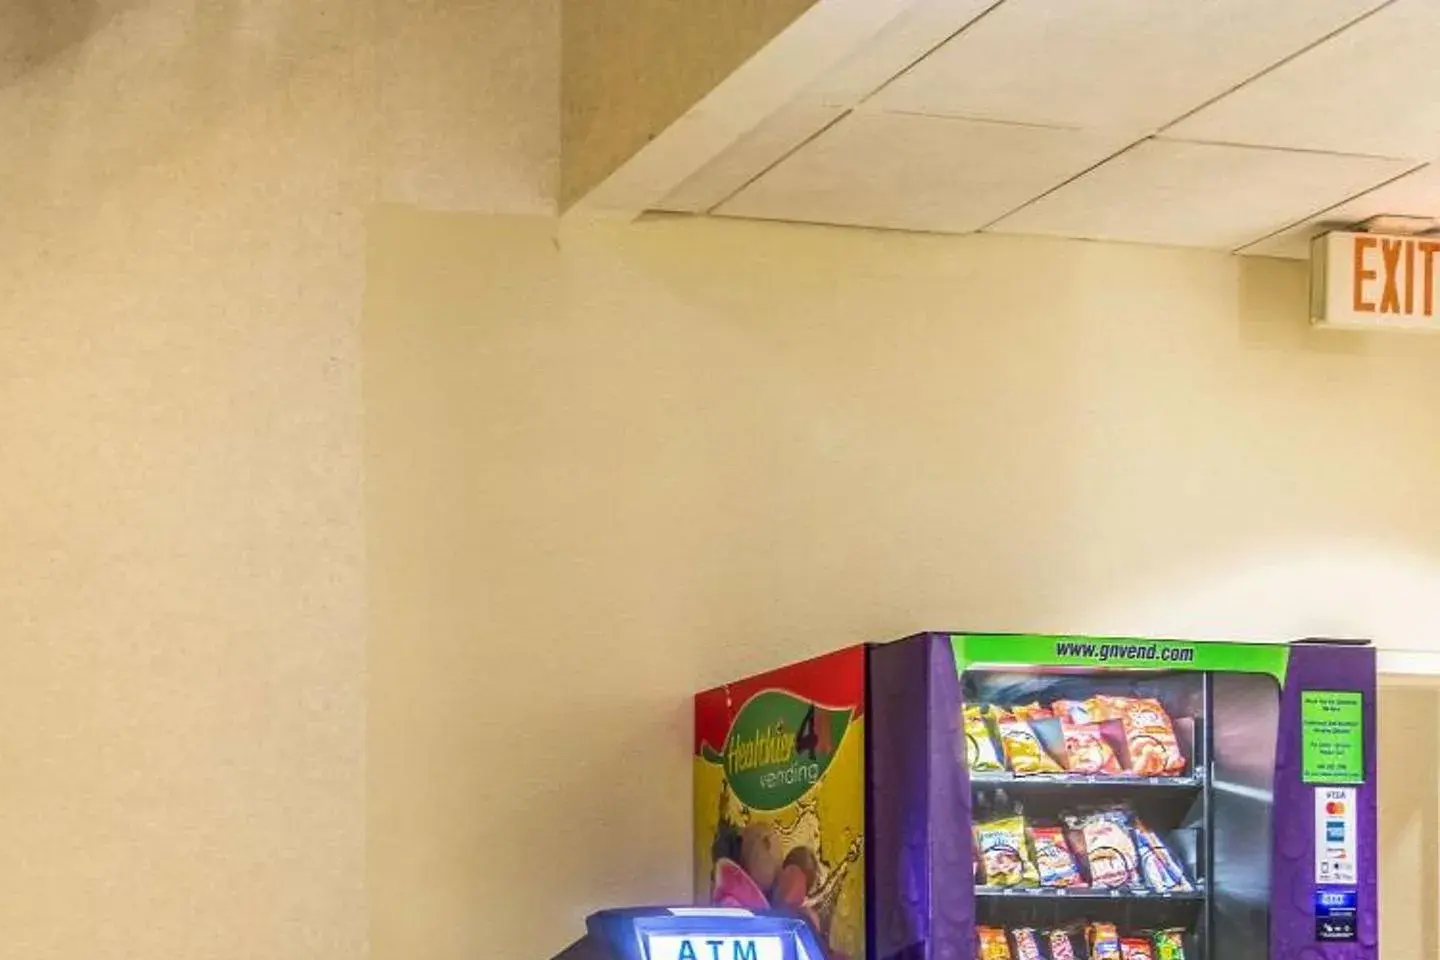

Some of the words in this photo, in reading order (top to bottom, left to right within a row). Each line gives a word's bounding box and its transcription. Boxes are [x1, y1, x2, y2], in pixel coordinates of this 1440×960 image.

[1353, 237, 1440, 317] EXIT
[1056, 643, 1193, 661] www.gnvend.com
[760, 763, 819, 788] vending
